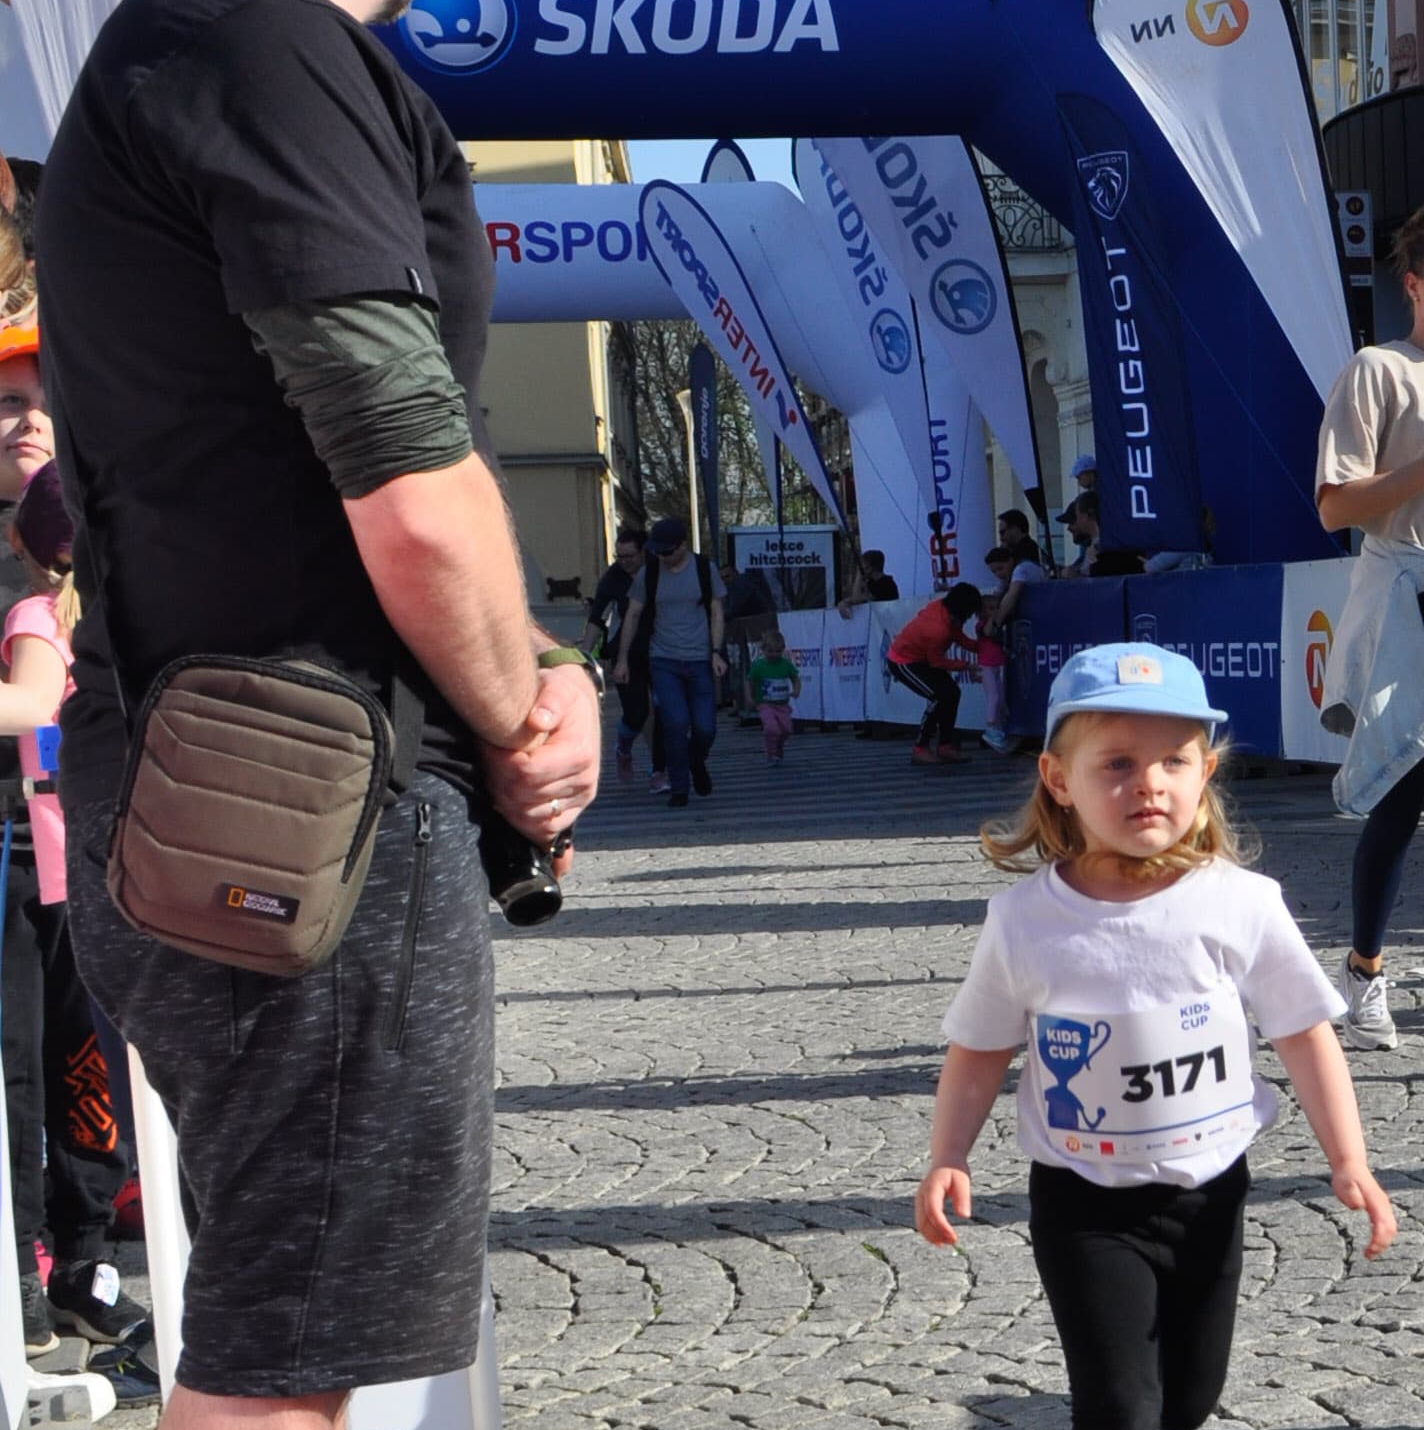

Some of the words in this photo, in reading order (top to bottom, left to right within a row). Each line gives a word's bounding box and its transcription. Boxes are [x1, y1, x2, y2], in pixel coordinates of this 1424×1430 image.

[1101, 235, 1157, 519] PEUGEOT
[750, 552, 821, 565] hitchcock
[1179, 1001, 1211, 1019] KIDS
[1180, 1015, 1209, 1031] CUP
[1045, 1027, 1082, 1045] KIDS
[1049, 1045, 1080, 1061] CUP
[1120, 1045, 1227, 1104] 3171
